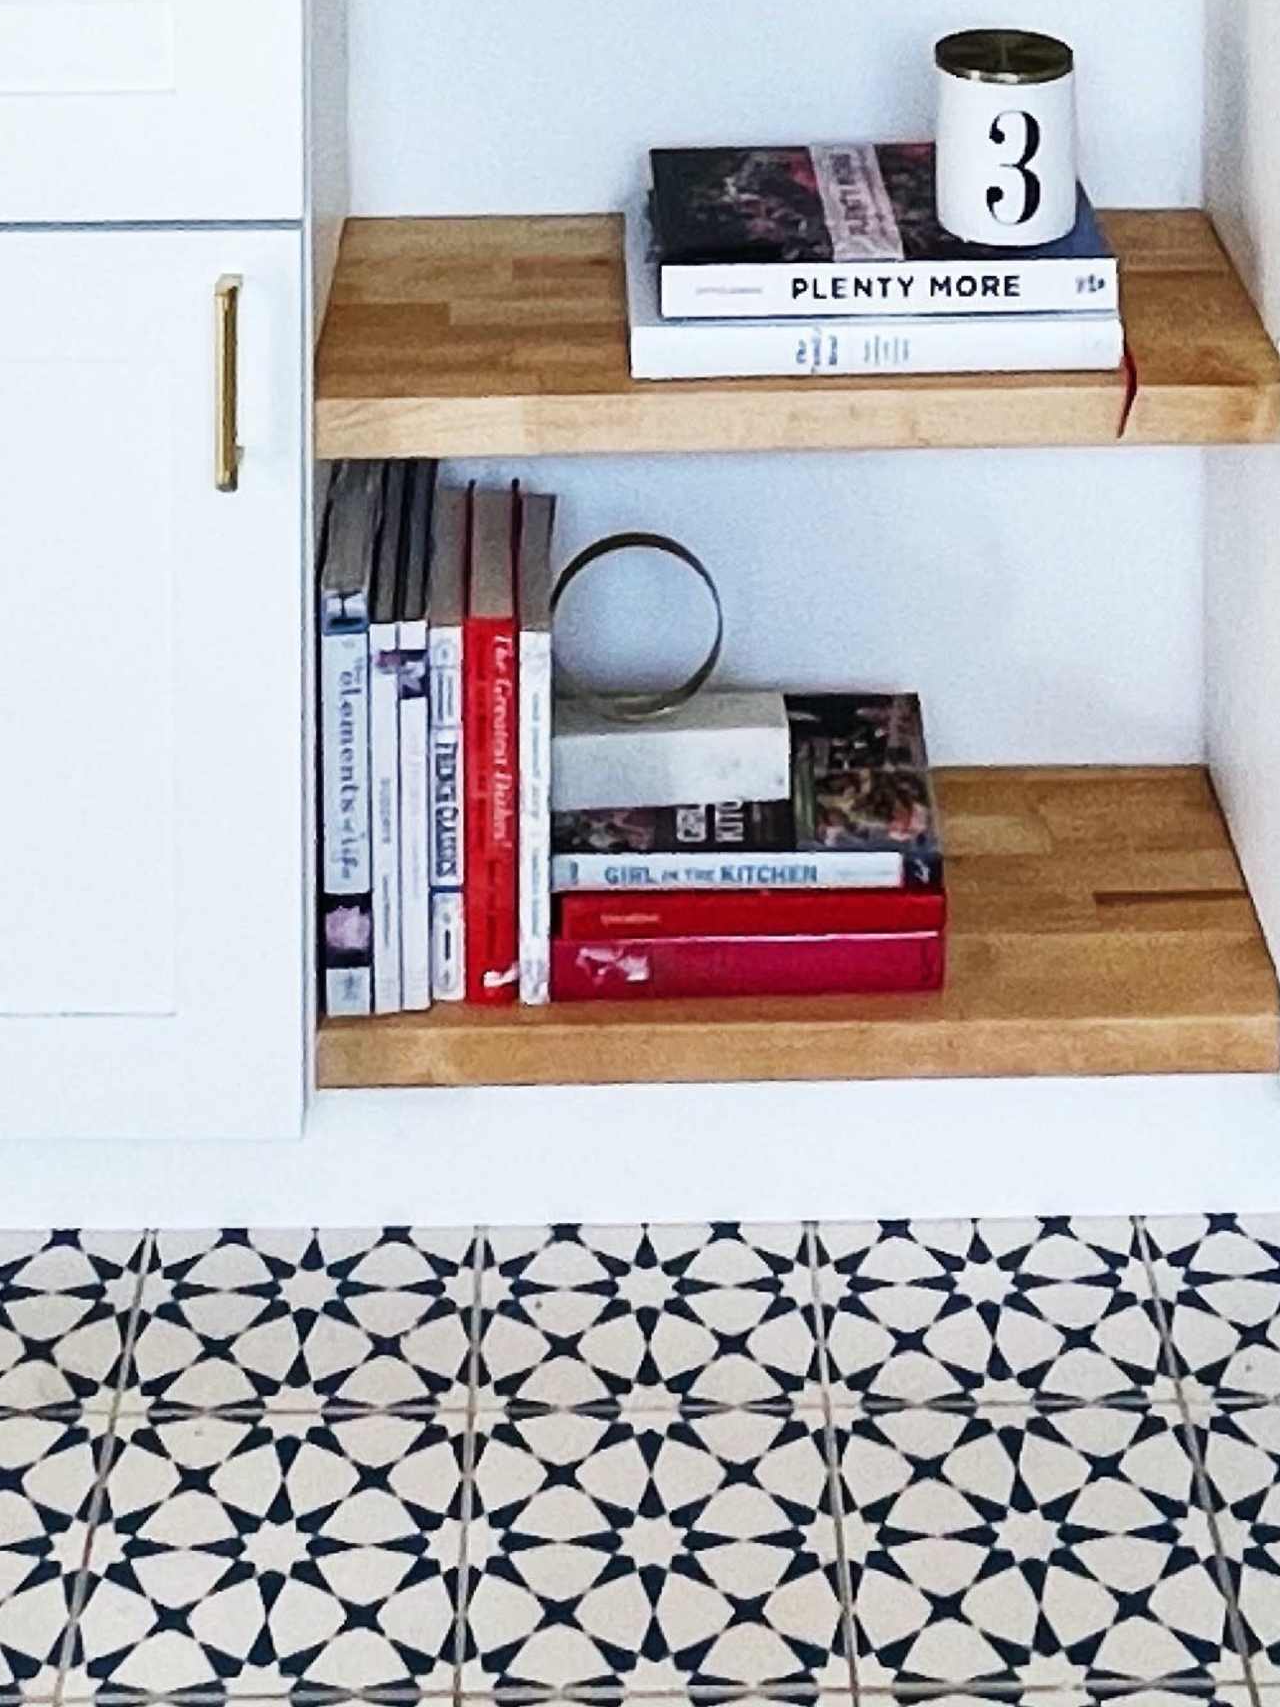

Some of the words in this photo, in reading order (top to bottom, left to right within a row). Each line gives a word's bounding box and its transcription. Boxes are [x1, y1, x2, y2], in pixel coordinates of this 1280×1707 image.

[985, 110, 1041, 225] 3
[792, 276, 916, 300] PLENTY
[928, 274, 1022, 298] MORE
[604, 865, 658, 885] GIRL
[720, 864, 818, 885] KITCHEN
